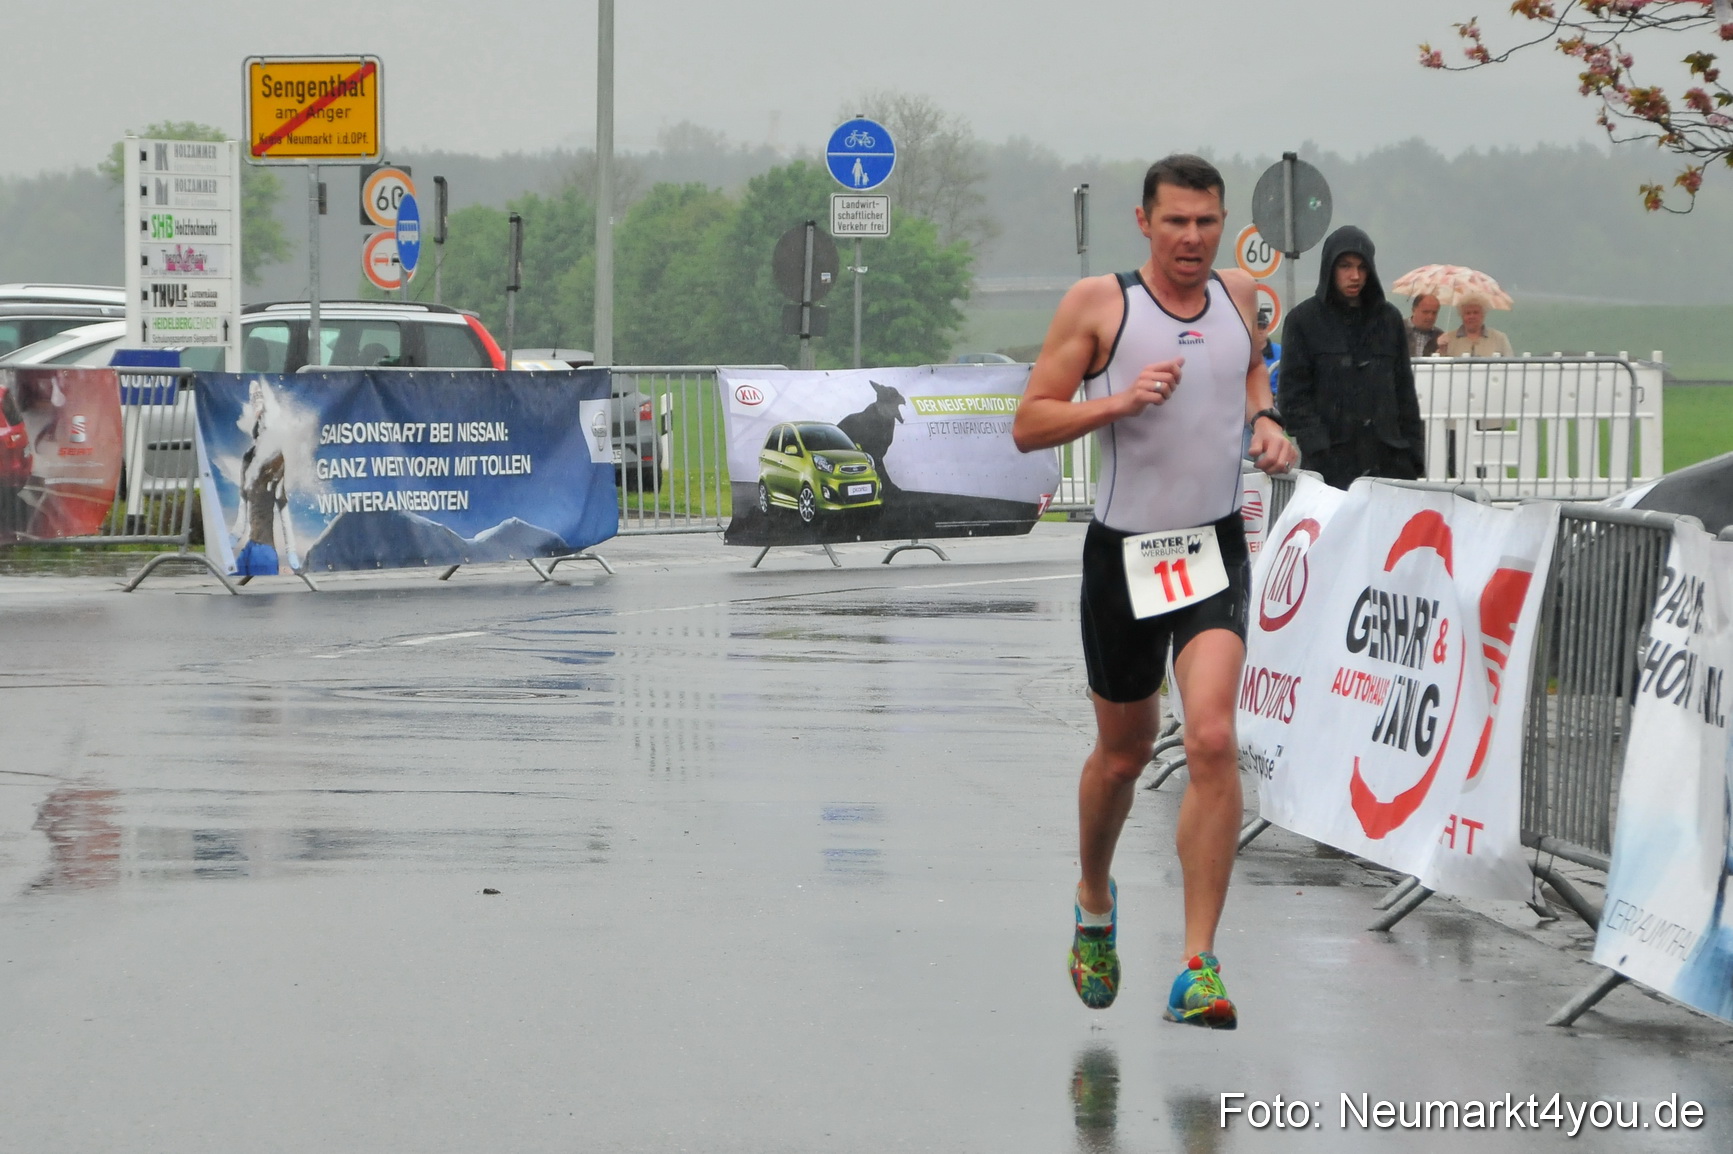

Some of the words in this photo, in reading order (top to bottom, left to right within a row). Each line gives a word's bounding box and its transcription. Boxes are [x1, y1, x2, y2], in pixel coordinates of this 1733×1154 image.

[262, 74, 365, 104] Sengenthal
[275, 108, 298, 119] am
[306, 106, 351, 122] Anger
[259, 133, 282, 145] Kreis
[287, 132, 332, 145] Neumarkt
[841, 200, 880, 209] Landwirt-
[837, 210, 884, 220] schaftlicher
[837, 221, 867, 231] Verkehr
[870, 221, 884, 231] frei
[1246, 240, 1271, 263] 60
[151, 283, 188, 308] THULE
[740, 389, 760, 401] KIA
[915, 399, 939, 412] DER
[939, 398, 967, 411] NEUE
[966, 397, 1005, 411] PICANTO
[320, 422, 425, 444] SAISONSTART
[429, 422, 453, 443] BEI
[457, 421, 508, 441] NISSAN:
[926, 421, 950, 437] JETZT
[952, 421, 997, 434] EINFANGEN
[316, 457, 367, 479] GANZ
[372, 456, 403, 477] WEIT
[405, 456, 449, 477] VORN
[454, 456, 477, 476] MIT
[480, 454, 531, 475] TOLLEN
[318, 490, 469, 514] WINTERANGEBOTEN
[1140, 536, 1185, 550] MEYER
[1141, 546, 1186, 558] WERBUNG
[1153, 558, 1194, 603] 11
[1240, 664, 1301, 724] MOTORS
